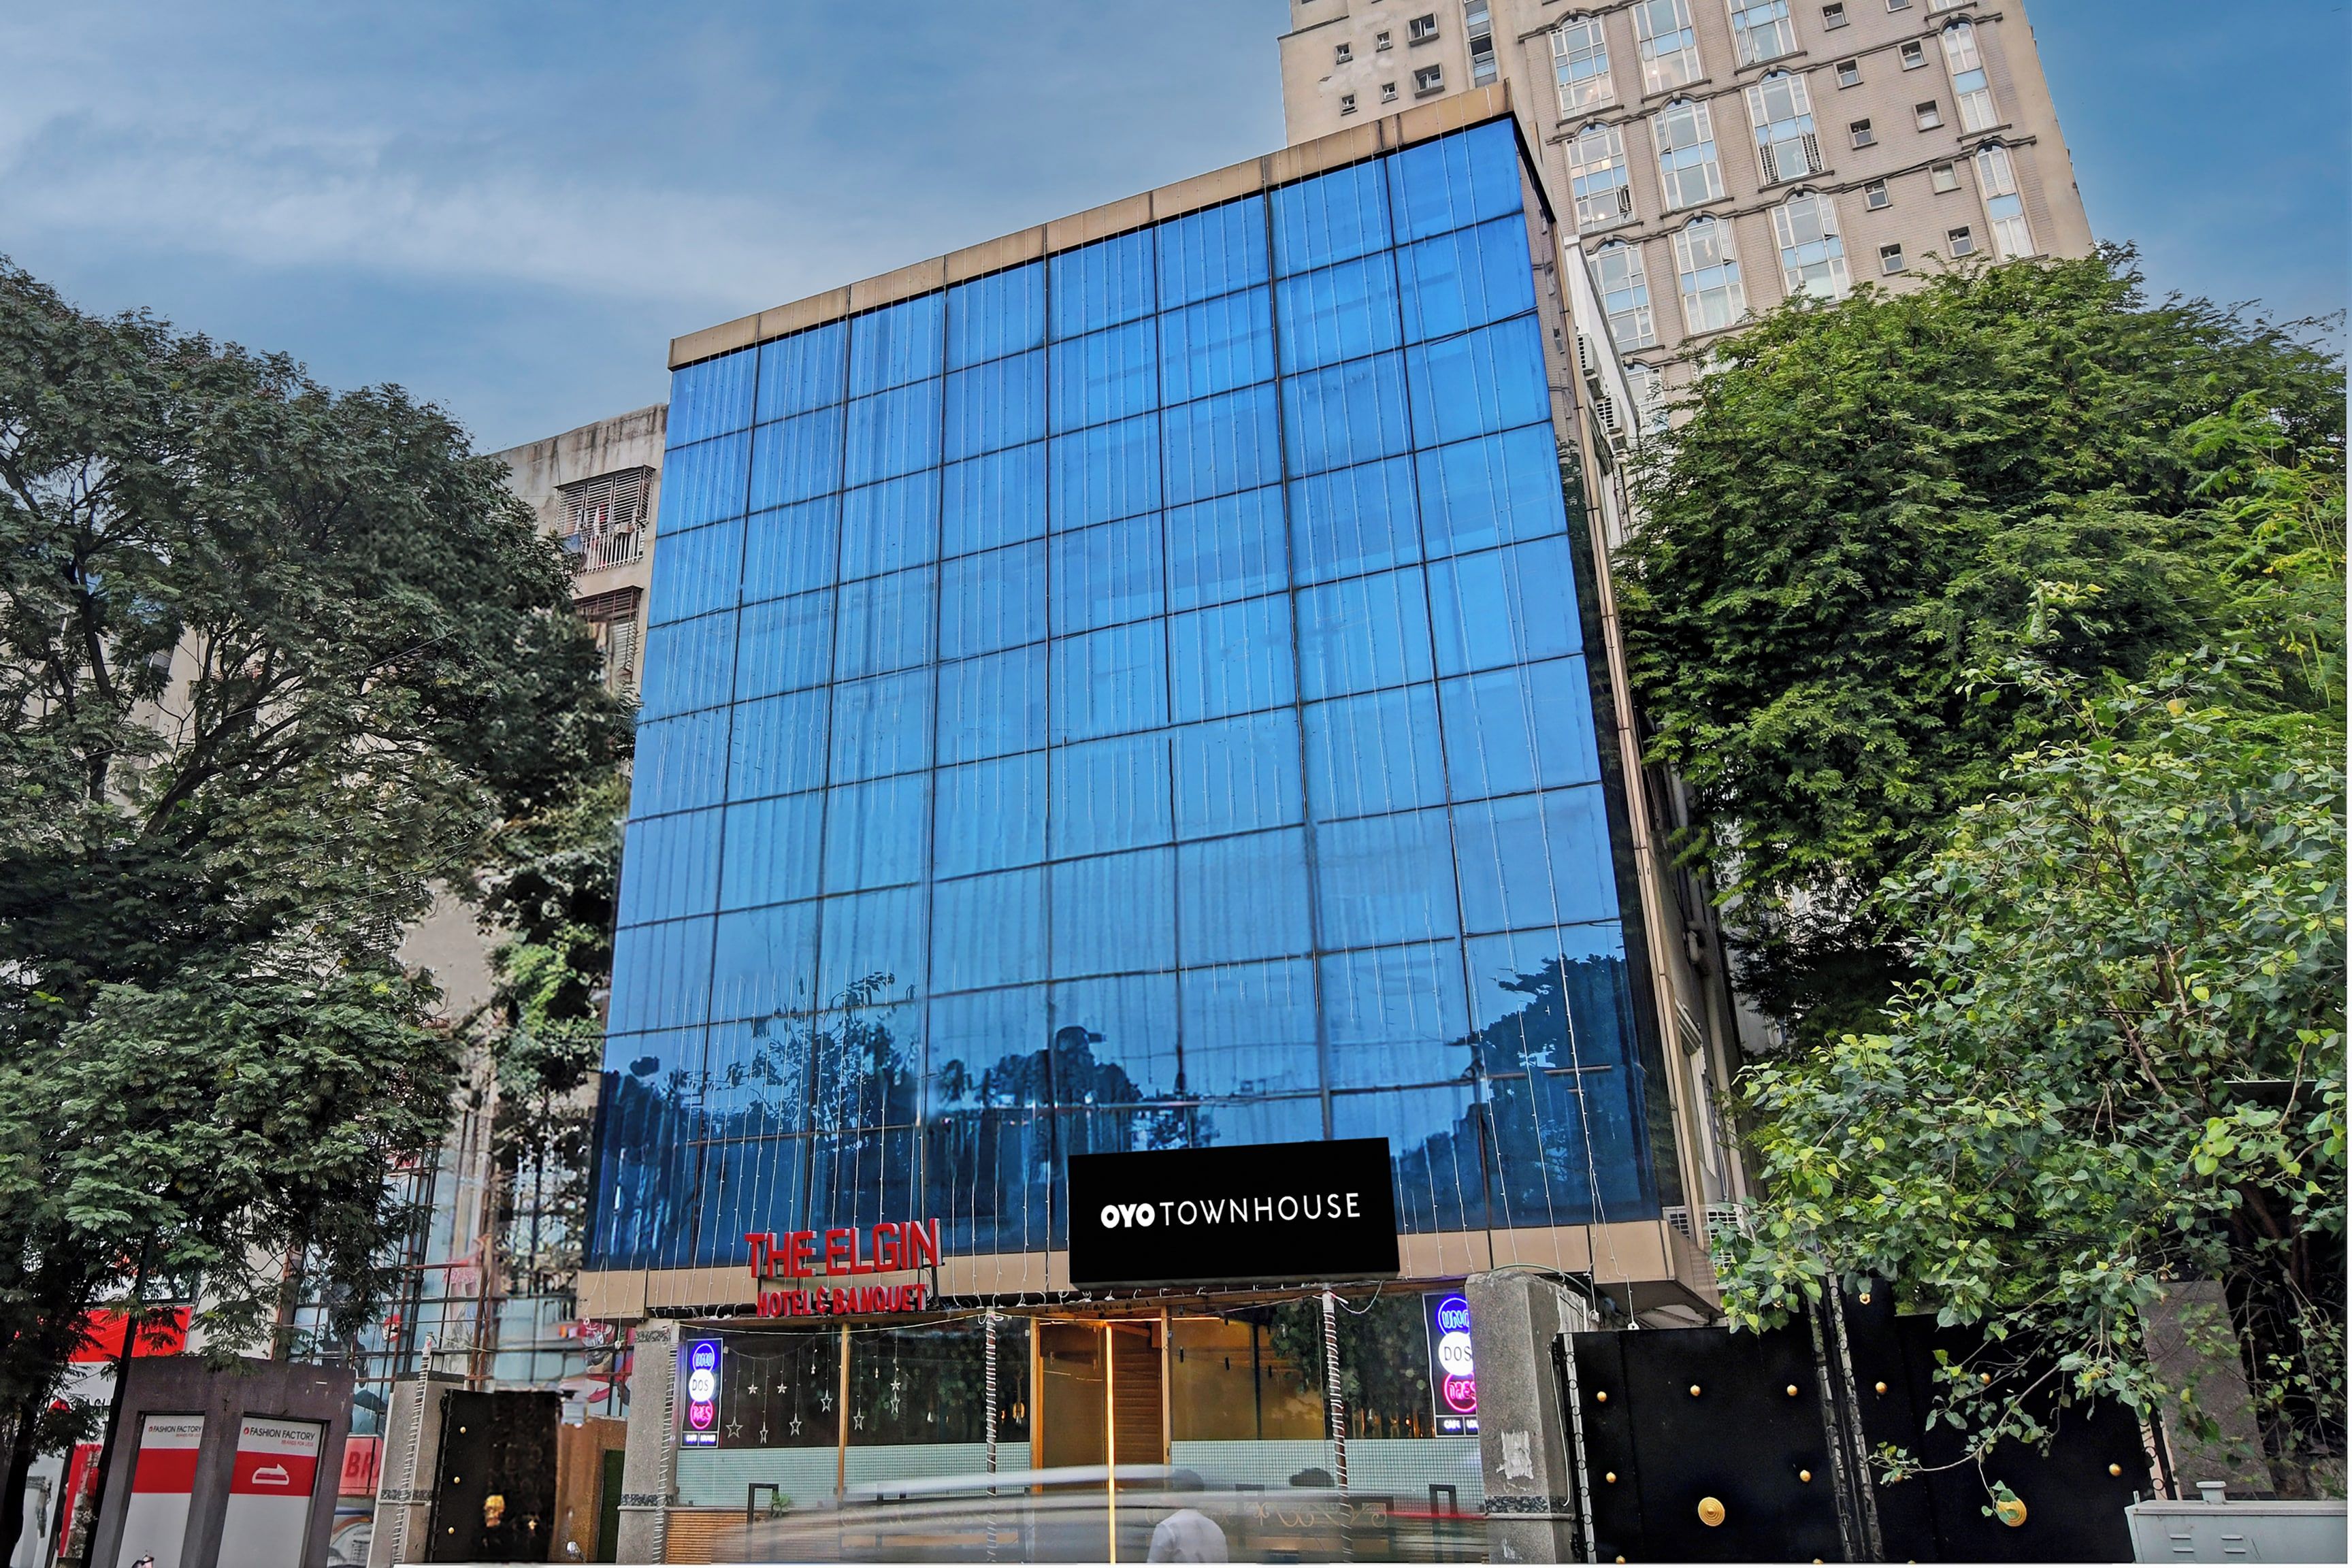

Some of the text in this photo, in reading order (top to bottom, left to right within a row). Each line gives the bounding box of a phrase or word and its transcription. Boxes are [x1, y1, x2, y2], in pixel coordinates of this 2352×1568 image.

[1100, 1192, 1360, 1228] OYO TOWNHOUSE
[745, 1218, 943, 1278] THE ELGIN
[757, 1288, 813, 1318] HOTEL
[832, 1284, 928, 1316] BANQUET
[1444, 1346, 1473, 1362] DOS
[692, 1379, 709, 1392] DOS
[250, 1427, 315, 1441] FASHION FACTORY
